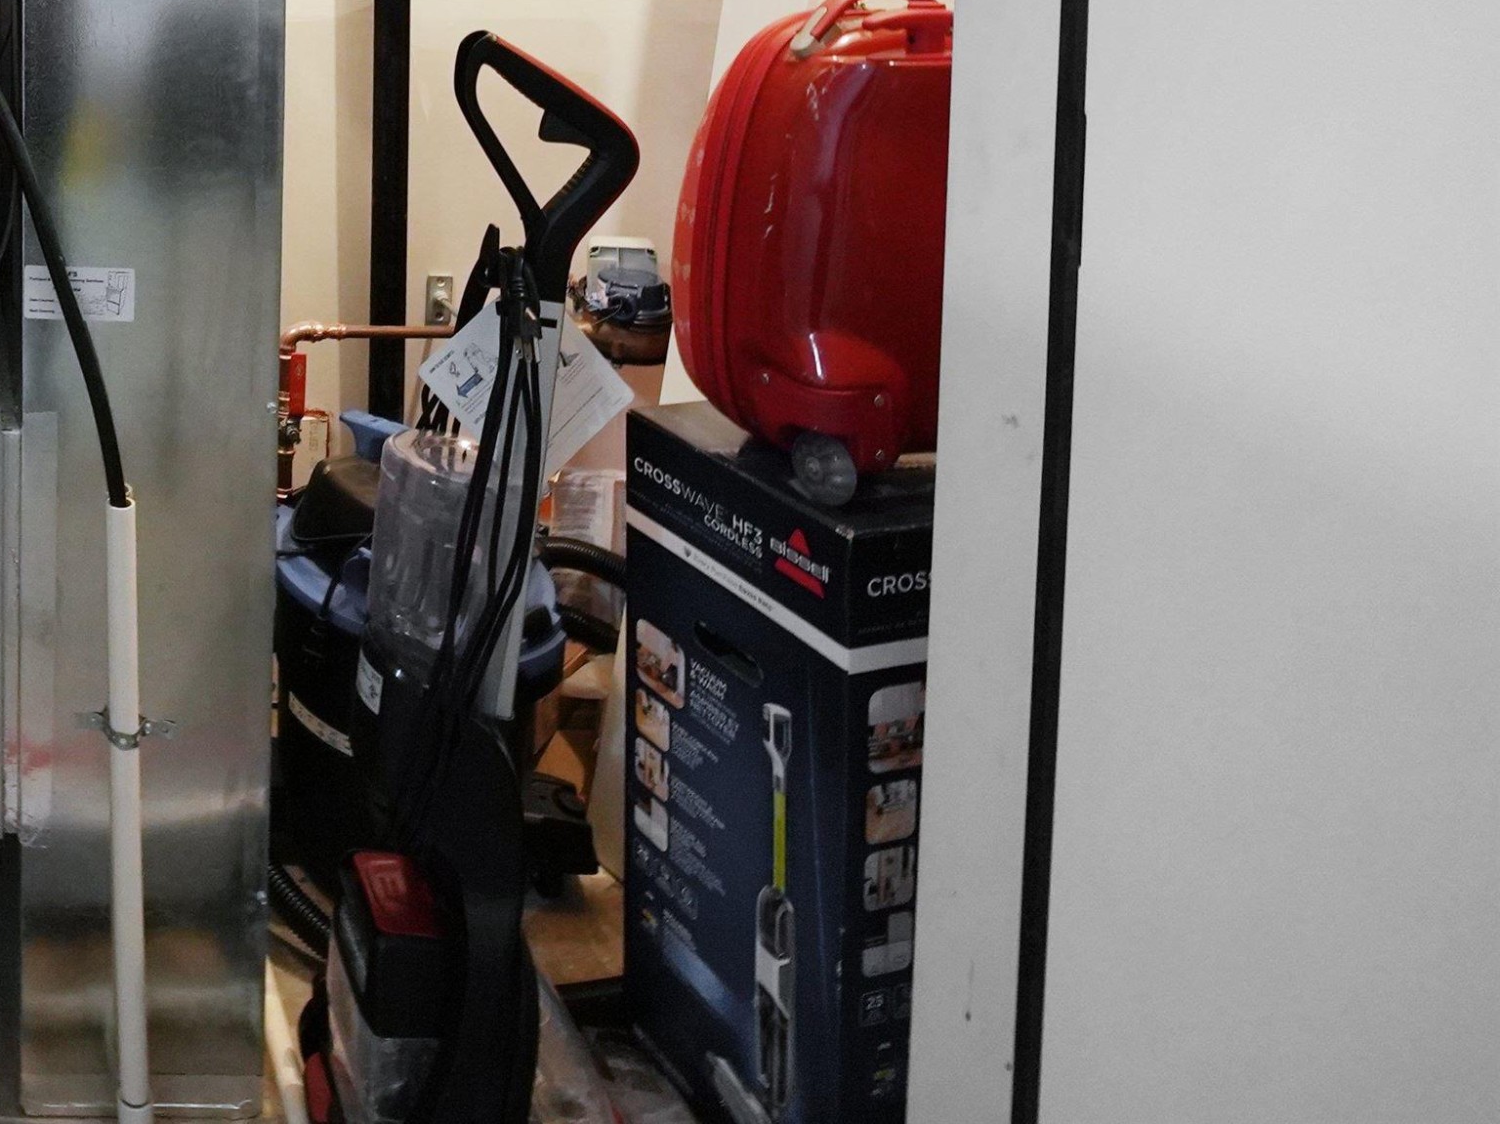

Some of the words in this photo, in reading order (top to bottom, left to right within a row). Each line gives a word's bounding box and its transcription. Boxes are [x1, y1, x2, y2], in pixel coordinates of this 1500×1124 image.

[633, 456, 726, 519] CROSSWAVE
[731, 513, 764, 546] HF3
[703, 514, 764, 560] CORDLESS
[866, 569, 931, 598] CROS
